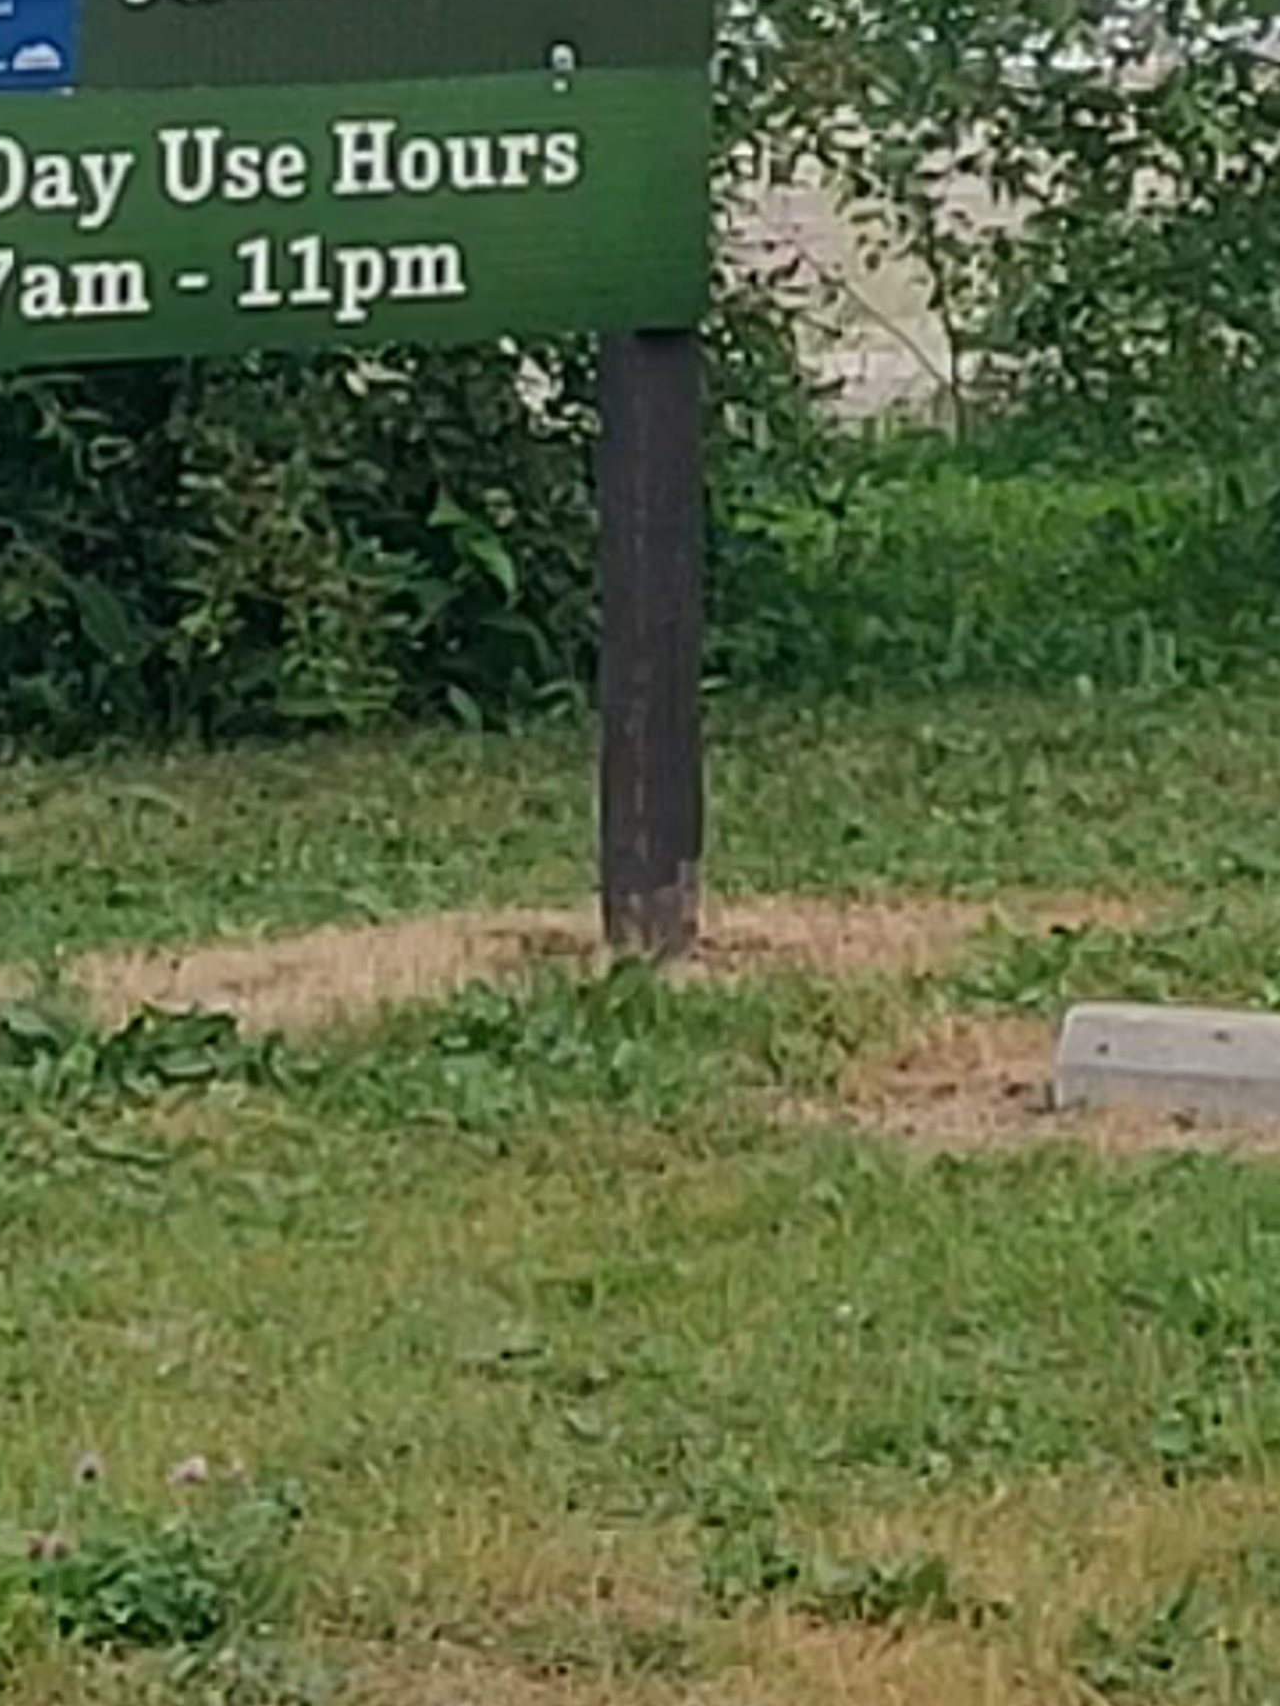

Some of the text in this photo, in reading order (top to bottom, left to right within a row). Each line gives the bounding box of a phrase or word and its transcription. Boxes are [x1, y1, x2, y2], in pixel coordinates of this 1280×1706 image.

[159, 127, 305, 202] Use
[334, 121, 578, 193] Hours
[238, 236, 465, 321] 11pm
